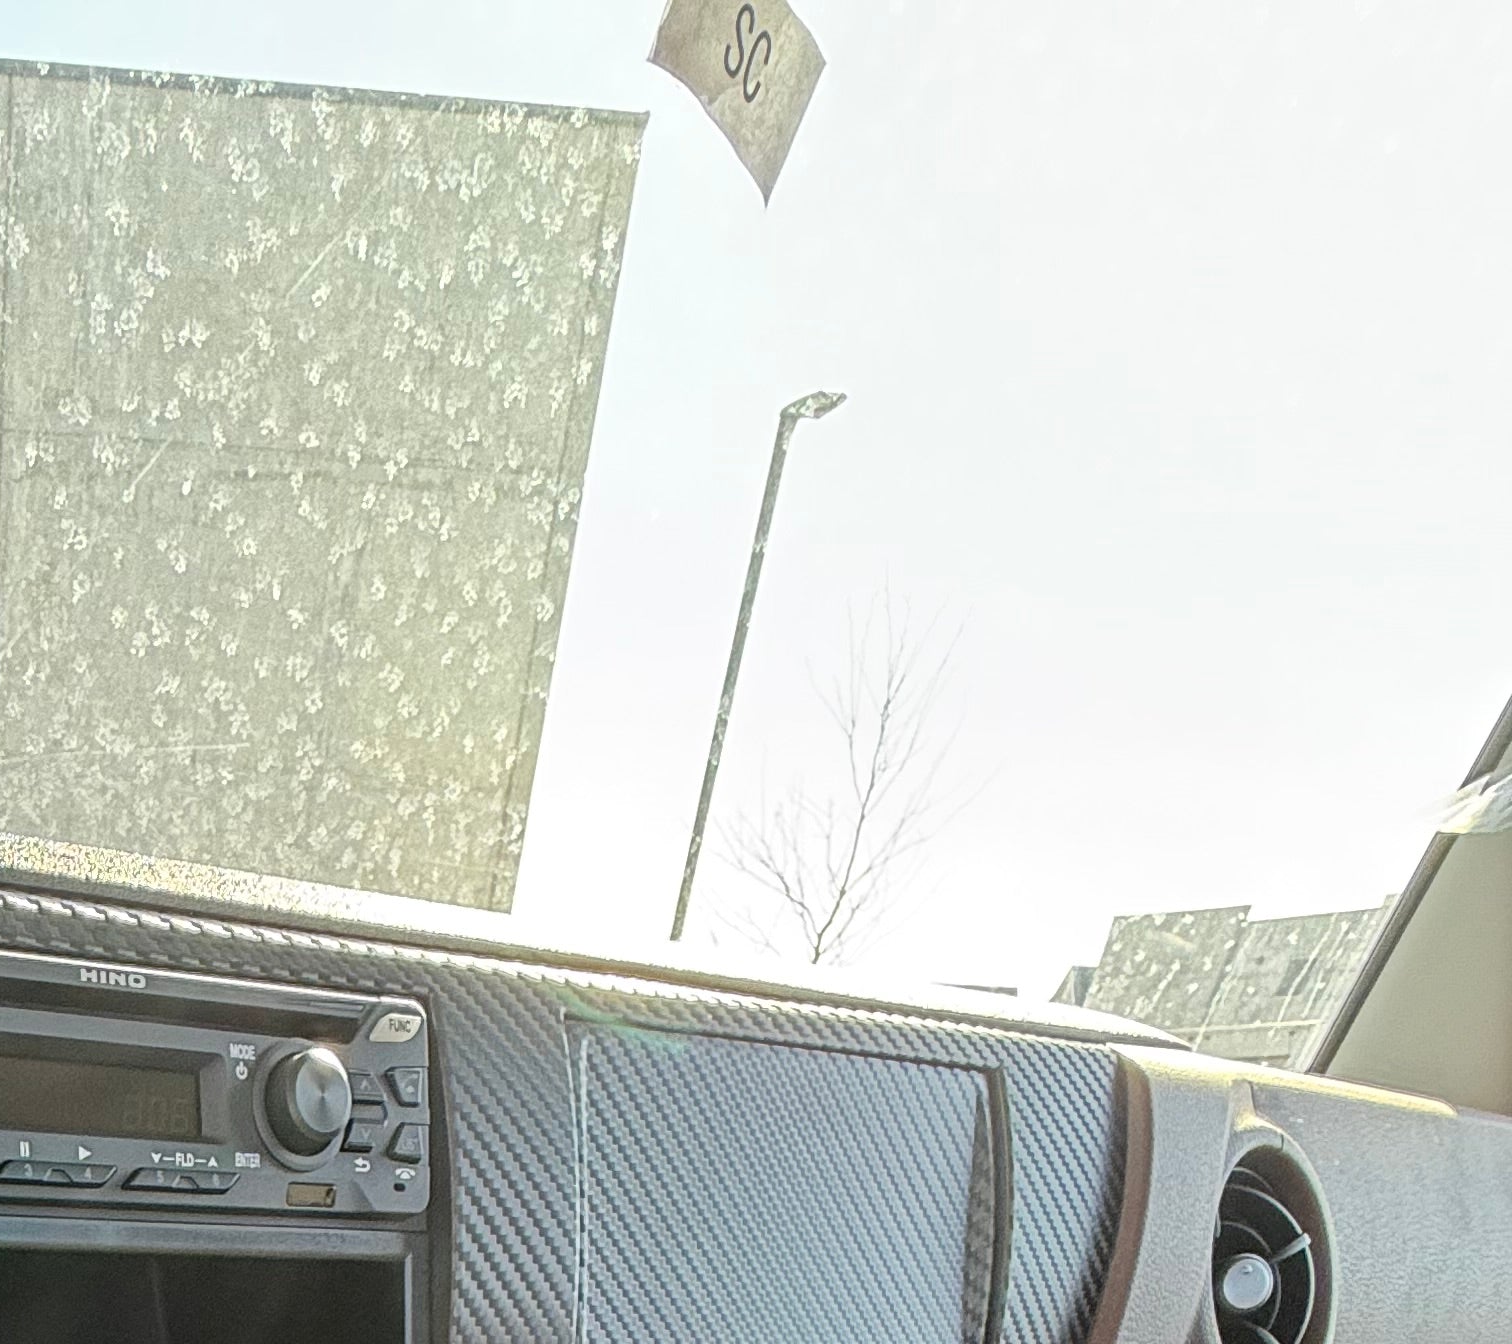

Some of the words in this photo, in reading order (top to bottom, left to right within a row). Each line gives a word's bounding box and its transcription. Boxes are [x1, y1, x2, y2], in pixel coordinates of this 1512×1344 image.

[80, 968, 147, 989] HINO
[389, 1019, 412, 1034] FUNC
[230, 1043, 255, 1060] MODE
[235, 1152, 261, 1168] ENTER
[24, 1163, 33, 1177] 3
